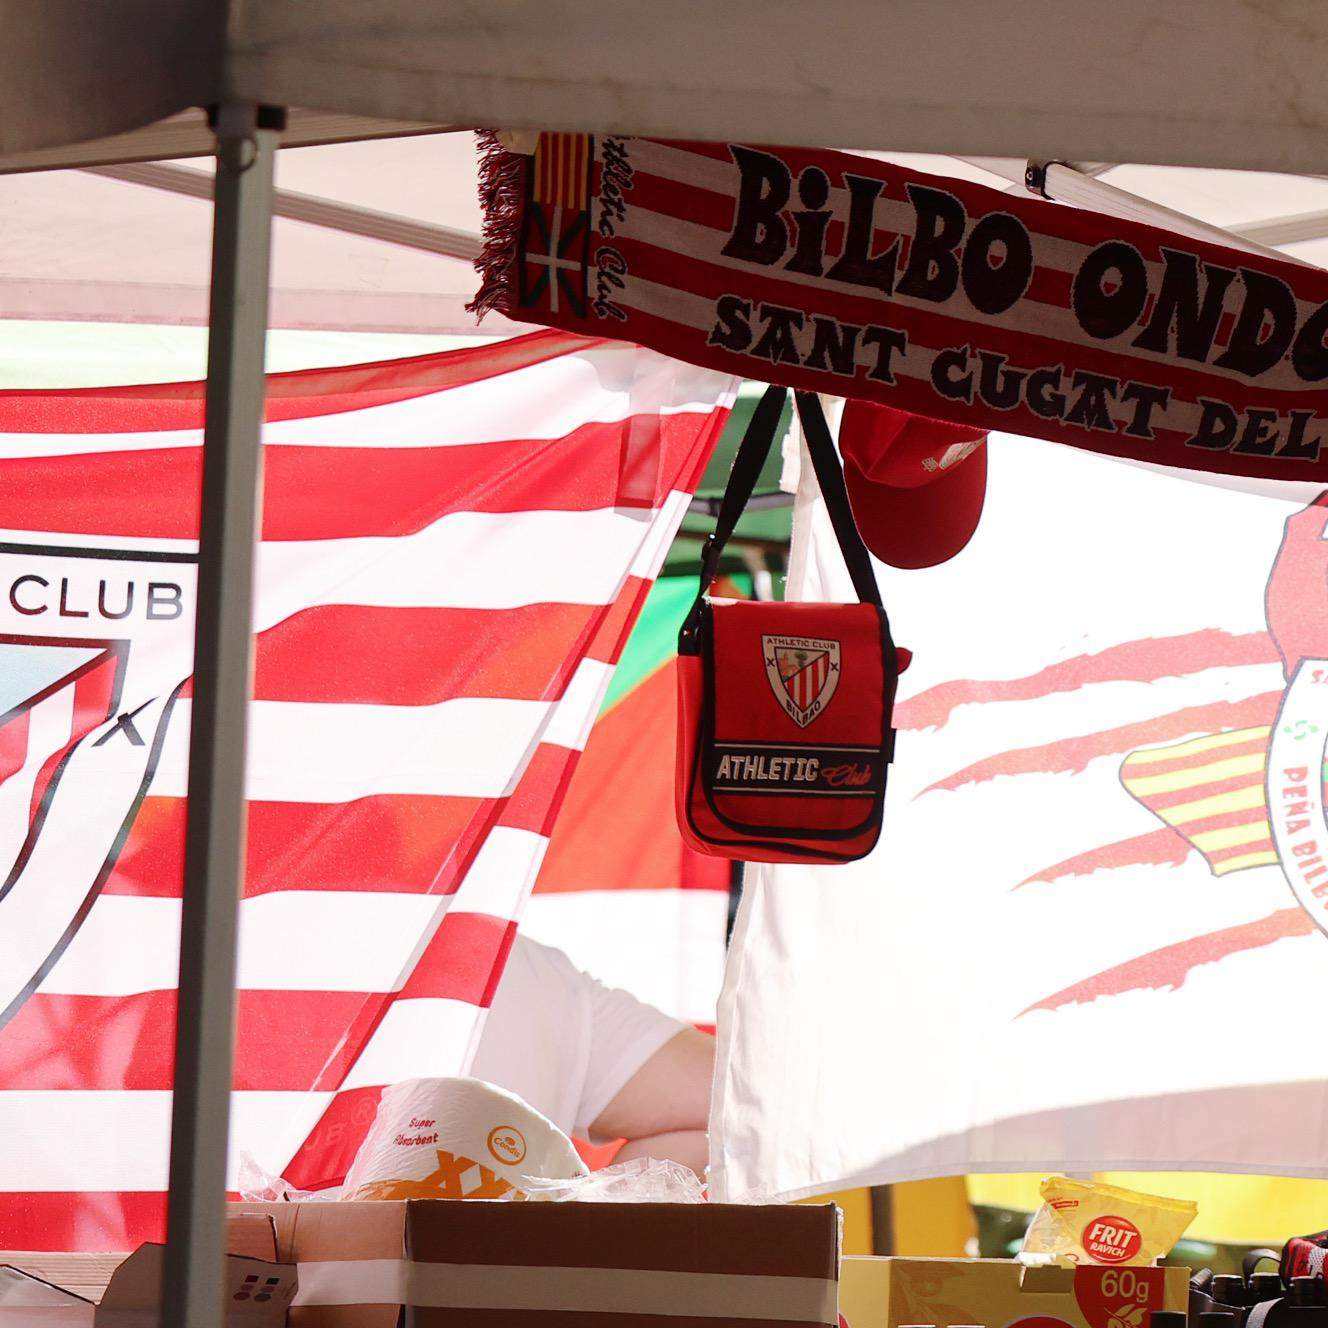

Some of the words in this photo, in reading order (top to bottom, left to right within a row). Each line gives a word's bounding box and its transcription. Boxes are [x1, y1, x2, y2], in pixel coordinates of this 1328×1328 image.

[599, 135, 637, 236] thletic
[594, 246, 627, 319] Club
[707, 293, 907, 385] SANT
[931, 341, 1170, 440] CUGAT
[1188, 395, 1324, 463] DEL
[9, 574, 183, 620] CLUB
[767, 638, 810, 647] ATHLETIC
[812, 641, 836, 649] CLUB
[785, 699, 821, 725] BILBAO
[716, 754, 820, 783] ATHLETIC
[820, 762, 872, 787] Club
[1282, 765, 1310, 835] PEÑA
[408, 1118, 437, 1130] Super
[1088, 1223, 1138, 1248] FRIT
[1089, 1243, 1126, 1258] RAVICH
[1101, 1269, 1150, 1303] 60g
